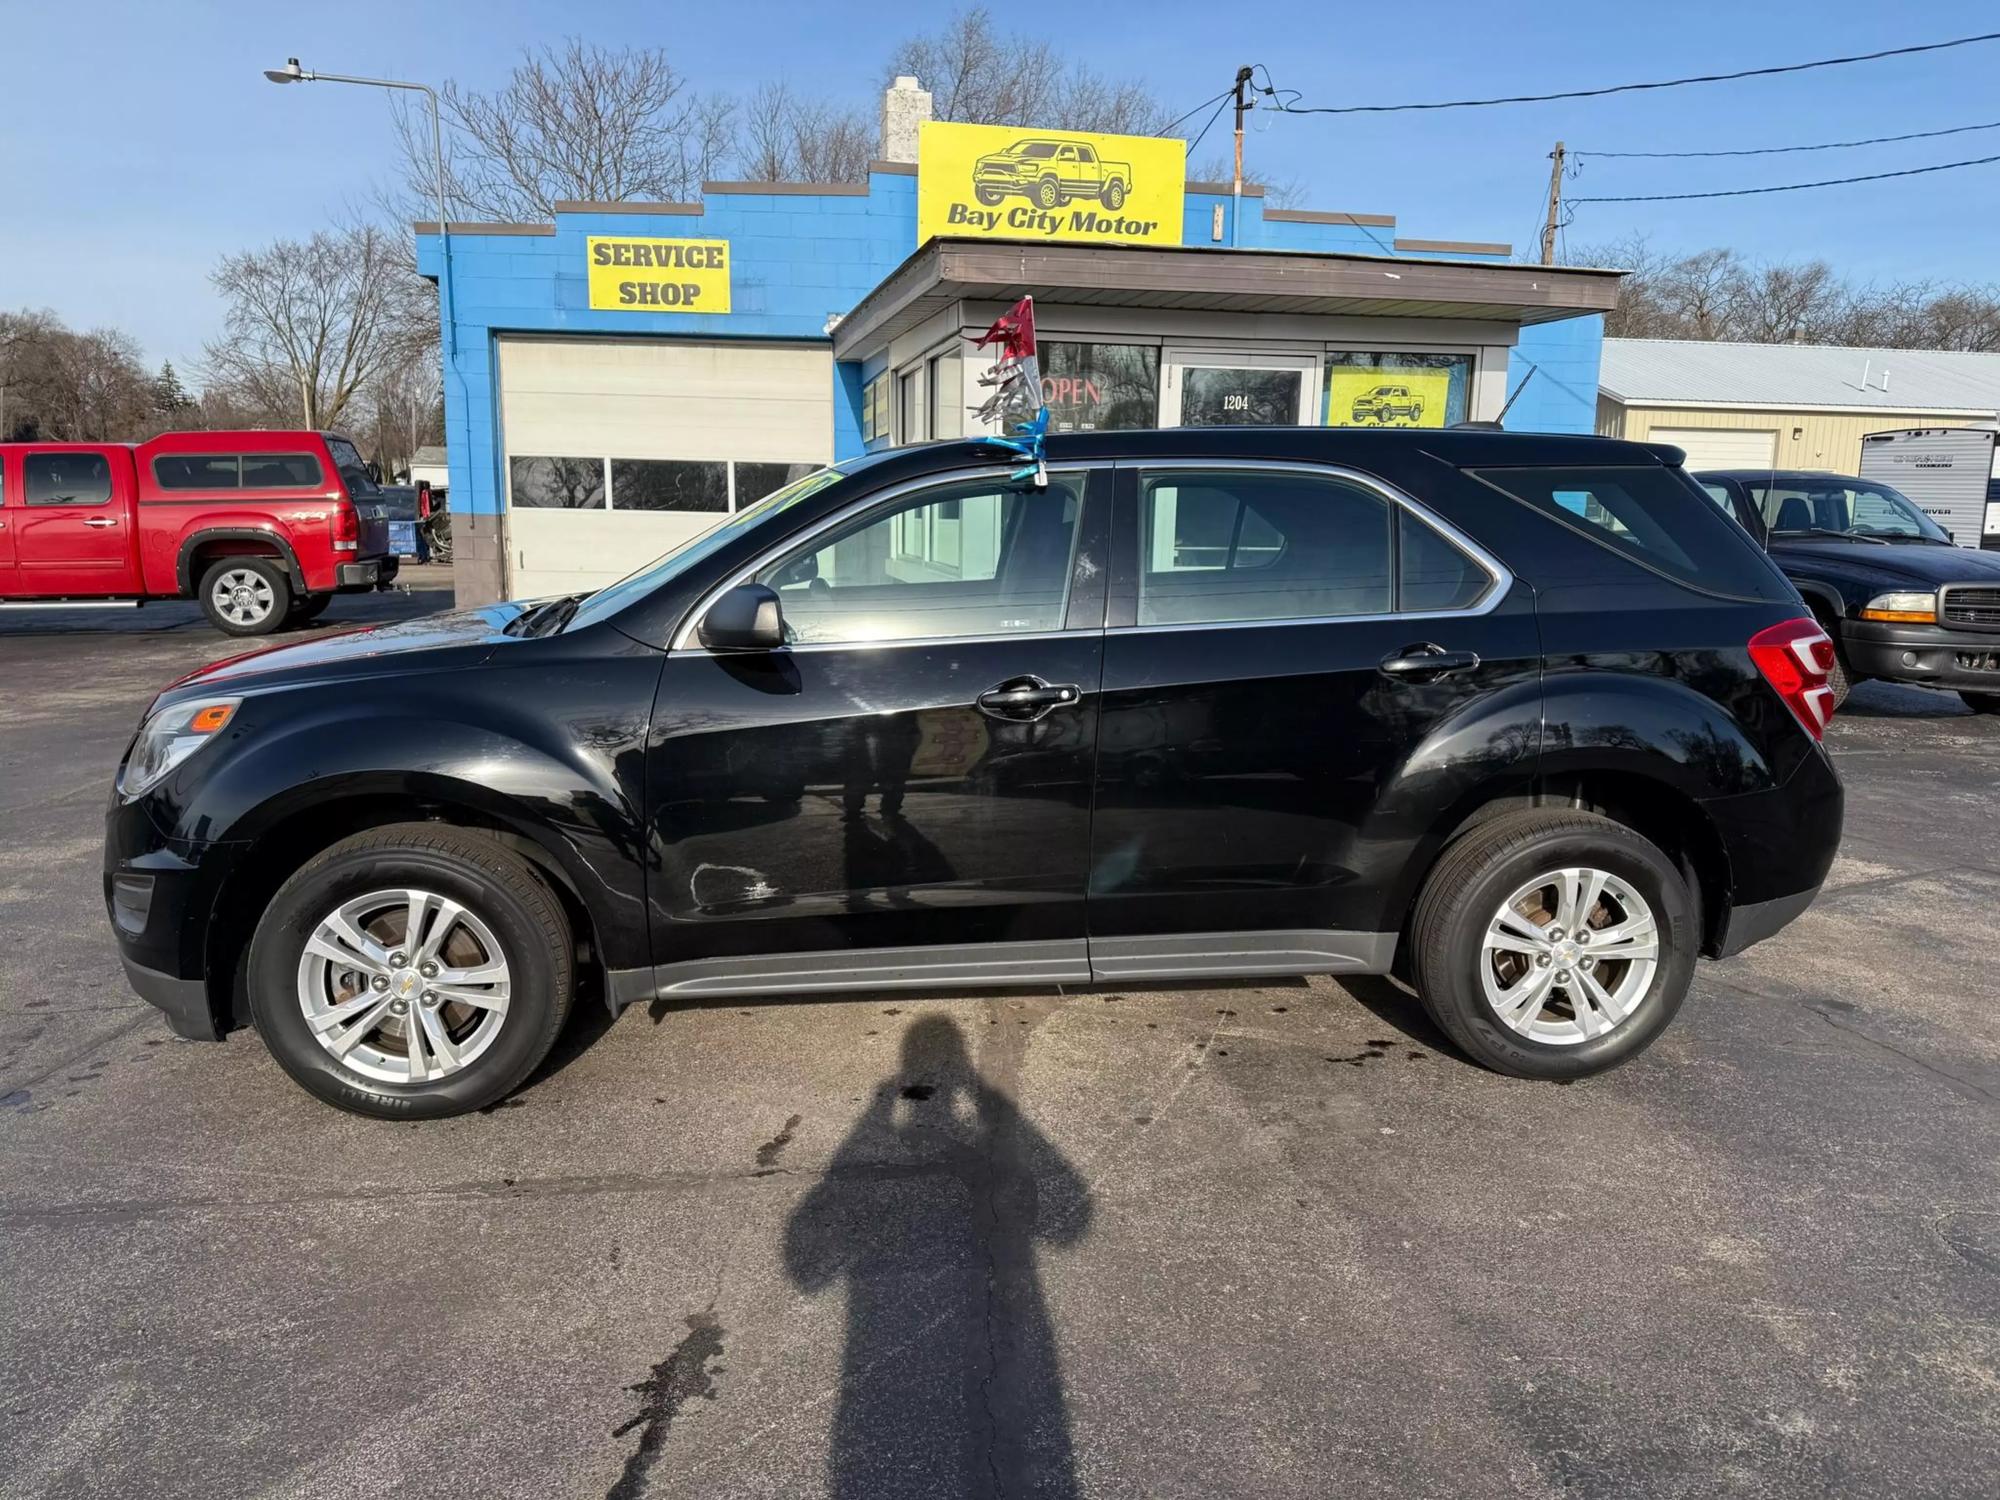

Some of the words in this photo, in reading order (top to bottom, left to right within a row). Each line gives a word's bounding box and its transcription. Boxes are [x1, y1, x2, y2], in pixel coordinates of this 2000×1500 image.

[947, 203, 1002, 231] Bay
[1007, 207, 1065, 235] City
[1068, 211, 1158, 236] Motor
[593, 243, 724, 269] SERVICE
[619, 281, 701, 306] SHOP
[1040, 376, 1100, 405] OPEN
[1223, 394, 1249, 410] 1204
